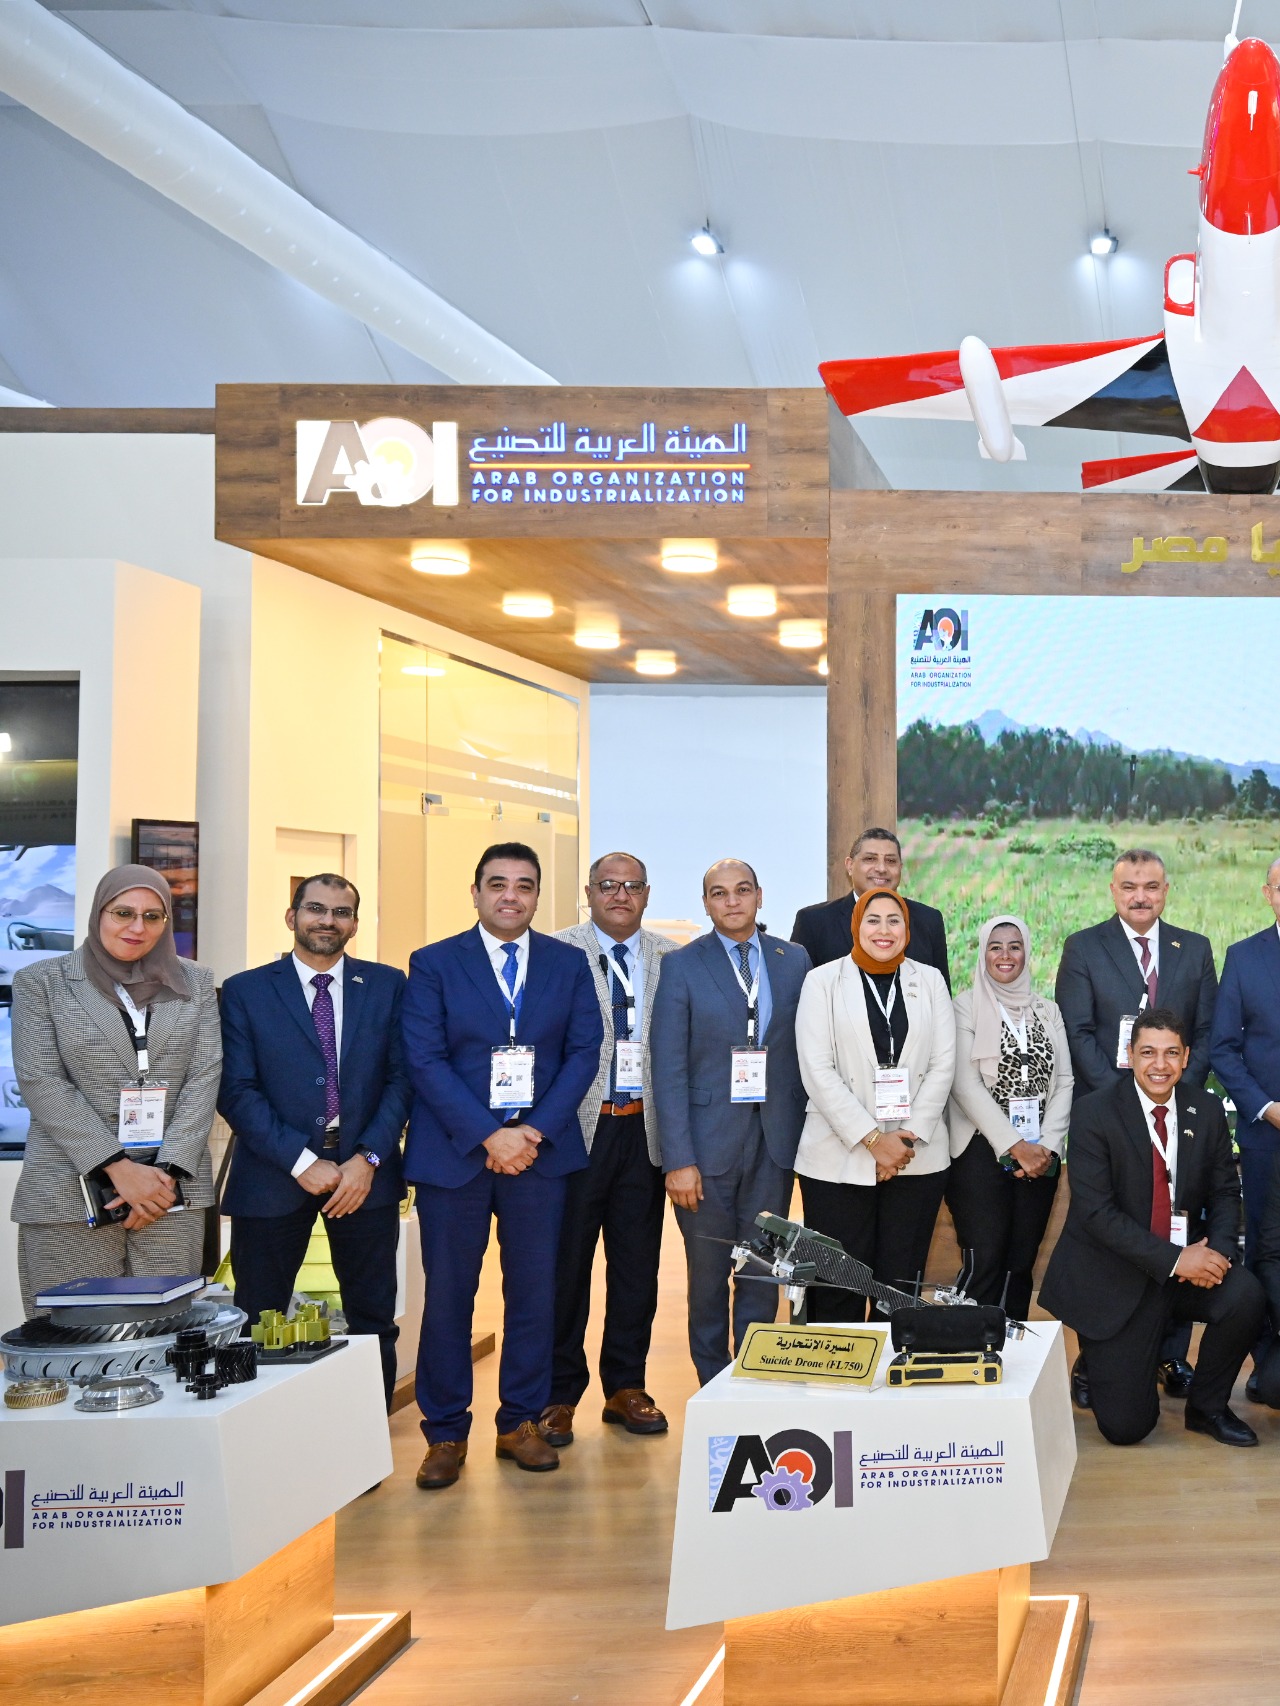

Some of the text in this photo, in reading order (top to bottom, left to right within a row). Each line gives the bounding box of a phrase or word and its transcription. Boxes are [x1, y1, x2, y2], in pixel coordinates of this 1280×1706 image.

[469, 423, 747, 462] الهيئة العربية للتصنيع
[472, 471, 745, 486] ARAB ORGANIZATION
[471, 488, 745, 503] FOR INDUSTRIALIZATION
[1121, 537, 1228, 573] مصر
[825, 1340, 854, 1353] المسيرة
[759, 1355, 863, 1372] Suicide Drone (FL750)
[859, 1440, 1004, 1467] الهيئة العربية للتصنيع
[861, 1466, 1003, 1479] ARAB ORGANIZATION
[860, 1476, 1003, 1489] FOR INDUSTRIALIZATION
[31, 1481, 184, 1507] الهيئة العربية للتصنيع
[33, 1508, 182, 1520] ARAB ORGANIZATION
[32, 1518, 182, 1530] FOR INDUSTRIALIZATION
